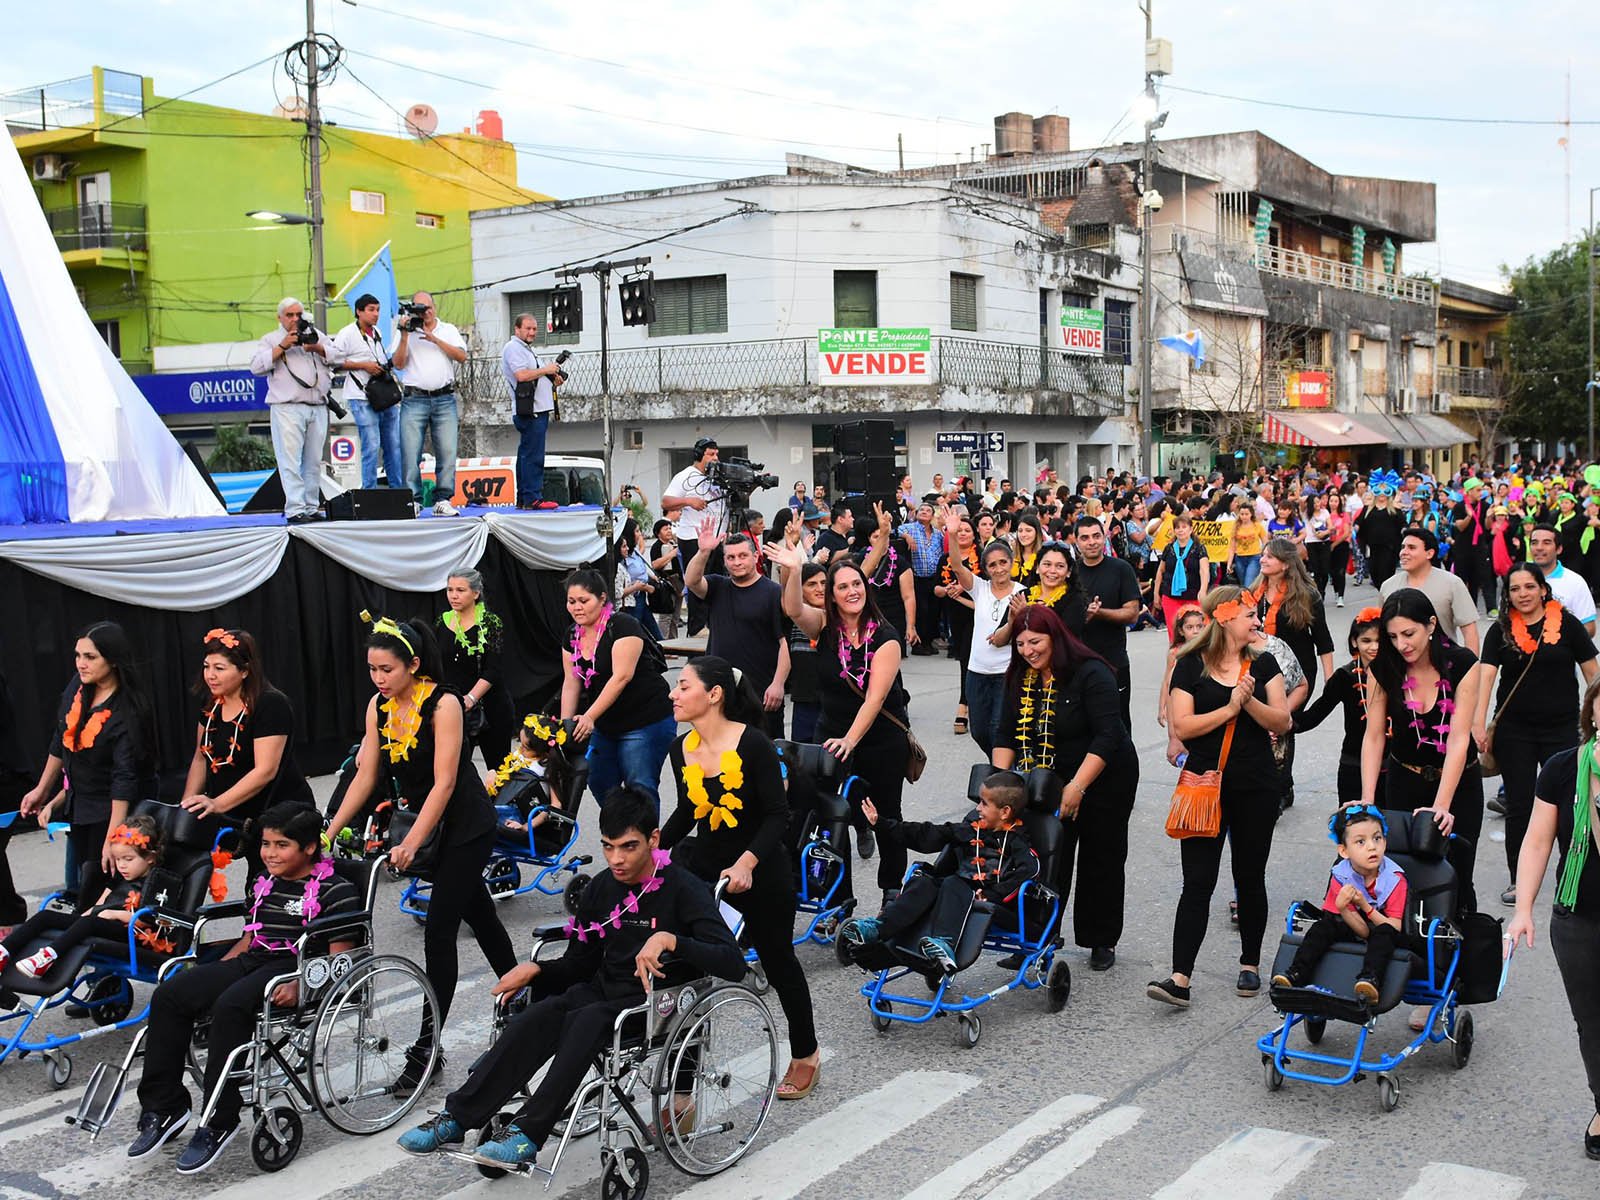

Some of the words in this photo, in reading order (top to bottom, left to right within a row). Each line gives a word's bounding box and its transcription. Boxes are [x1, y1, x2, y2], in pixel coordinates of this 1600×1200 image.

[820, 330, 878, 342] PONTE
[880, 331, 928, 342] Propiedades
[1063, 328, 1101, 348] VENDE
[825, 353, 926, 374] VENDE
[203, 379, 255, 394] NACION
[204, 394, 255, 403] SEGUROS
[337, 442, 349, 457] E
[471, 477, 507, 498] 107
